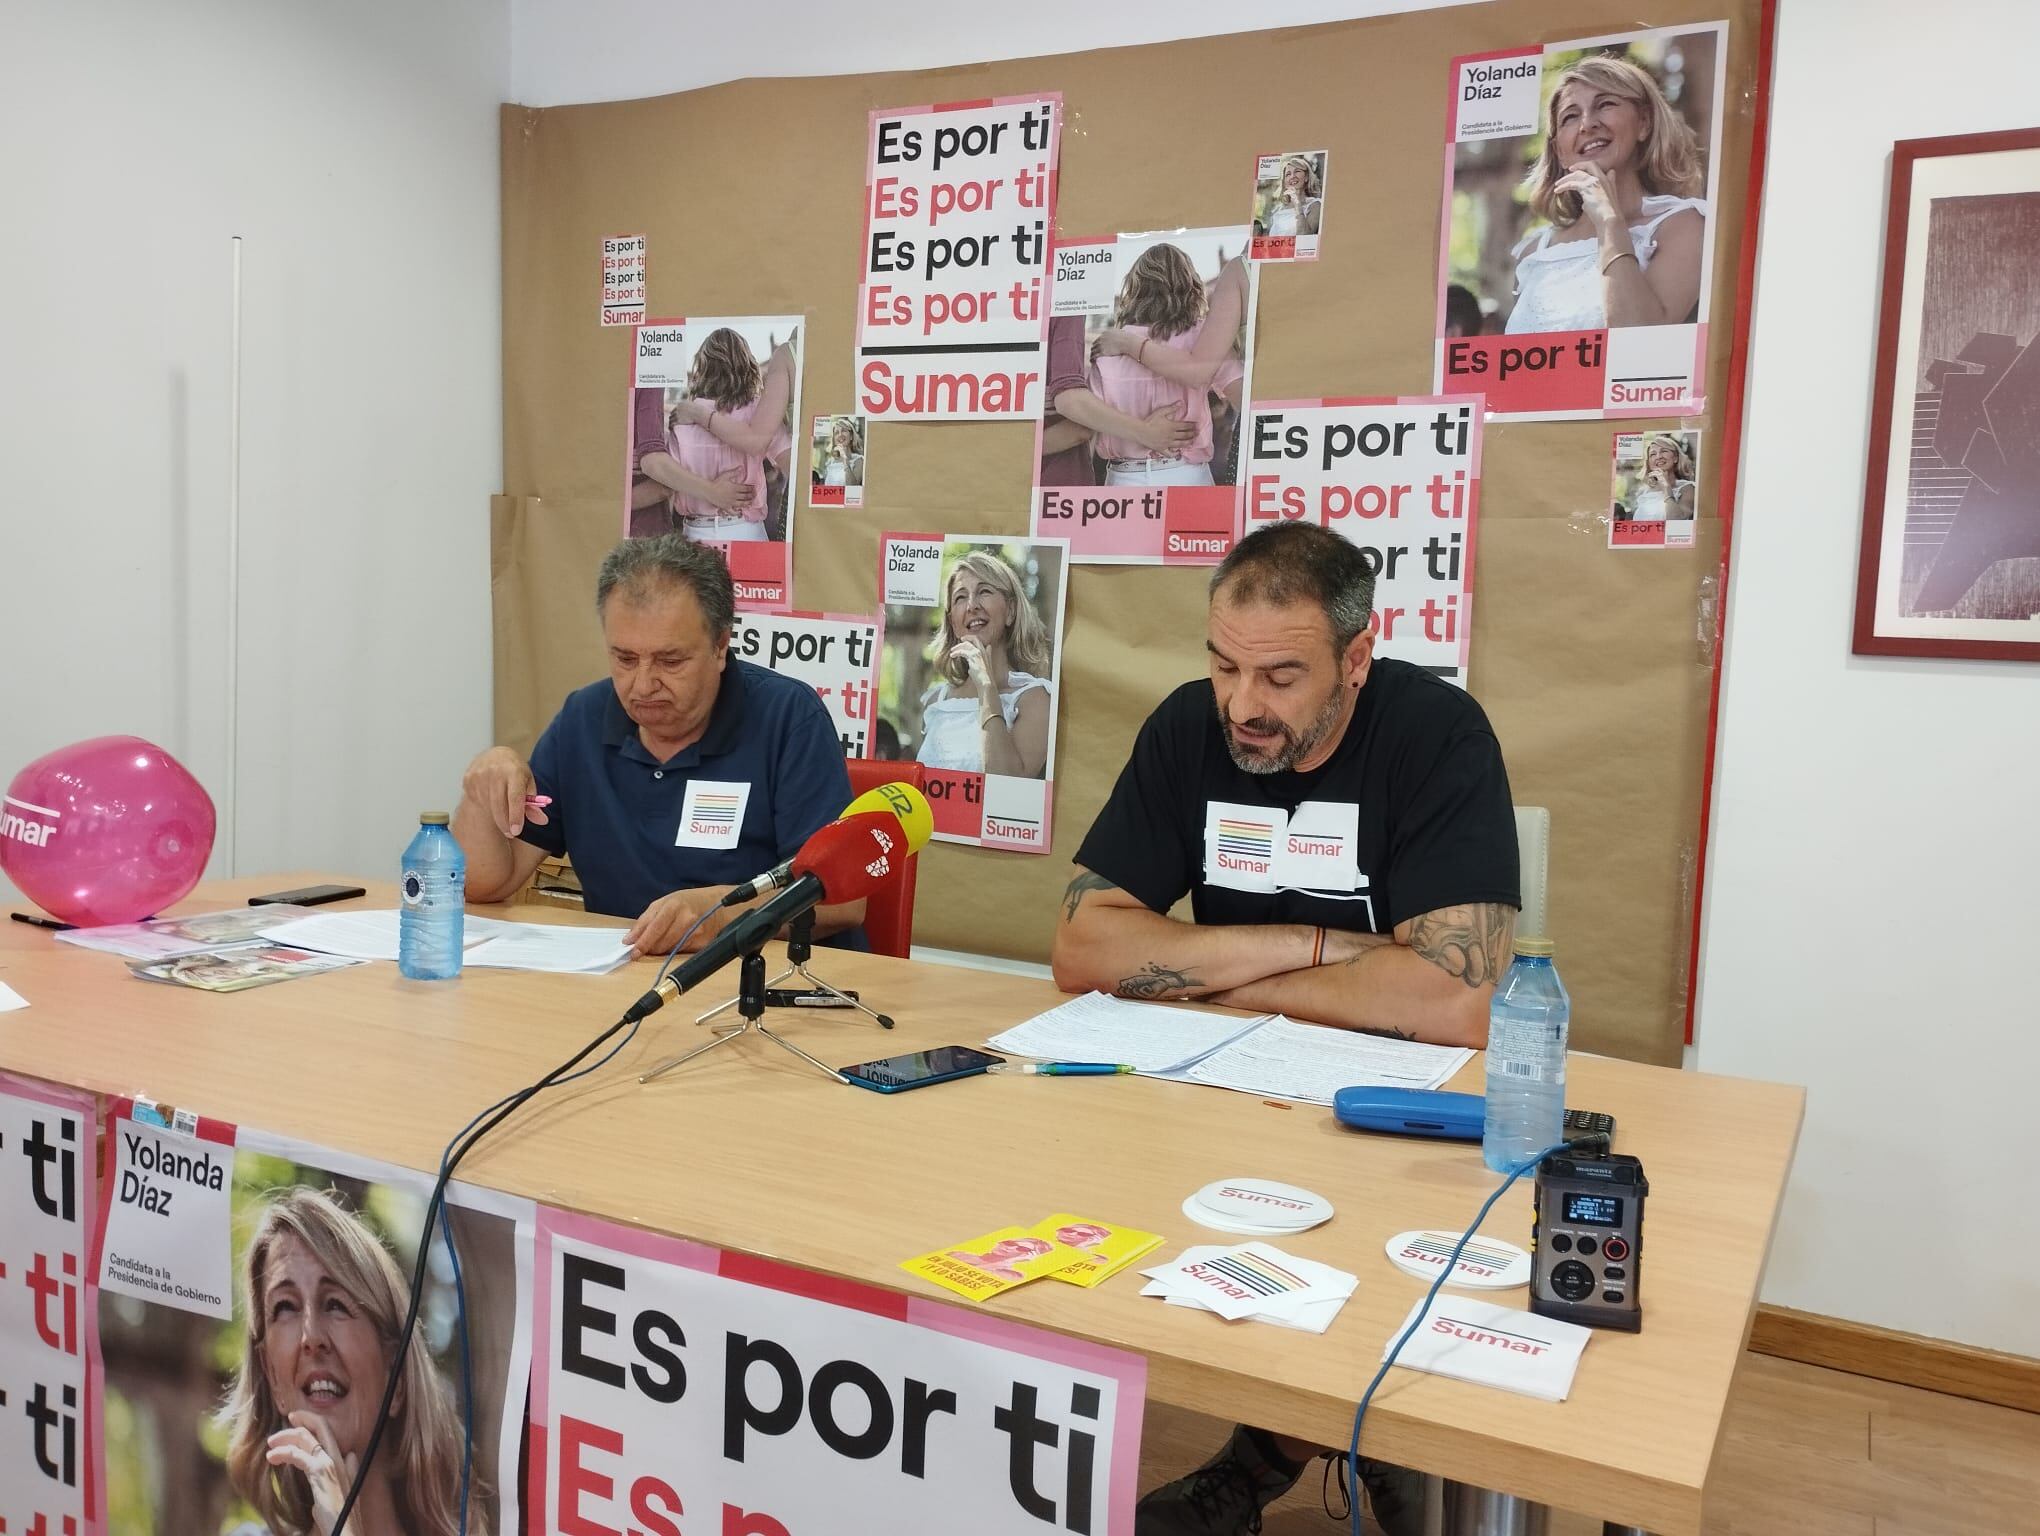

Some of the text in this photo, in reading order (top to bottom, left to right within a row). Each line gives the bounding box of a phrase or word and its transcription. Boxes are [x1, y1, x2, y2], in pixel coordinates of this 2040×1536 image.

[1467, 62, 1537, 84] Yolanda
[1464, 84, 1502, 101] Díaz
[1461, 121, 1492, 130] Candidata
[1461, 128, 1496, 136] Presidencia
[1504, 124, 1532, 132] Gobierno
[878, 106, 1050, 171] Es por ti
[874, 163, 1046, 226] Es por ti
[604, 238, 644, 255] Es por ti
[870, 221, 1044, 280] Es por ti
[1253, 240, 1264, 248] Es
[604, 254, 644, 270] Es por ti
[1058, 249, 1112, 266] Yolanda
[605, 269, 644, 286] Es por ti
[1056, 266, 1086, 282] Díaz
[605, 285, 644, 302] Es por ti
[603, 309, 644, 324] Sumar
[868, 278, 1040, 336] Es por ti
[640, 329, 683, 343] Yolanda
[640, 344, 662, 357] Díaz
[1448, 334, 1602, 380] Es por ti
[862, 361, 1038, 414] Sumar
[1610, 384, 1686, 403] Sumar
[1253, 408, 1470, 470] Es por ti
[812, 486, 822, 495] Es
[824, 488, 837, 496] por
[1251, 470, 1465, 528] Es por ti
[1042, 490, 1163, 526] Es por ti
[1614, 522, 1664, 535] Es por ti
[890, 544, 940, 559] Yolanda
[1168, 534, 1229, 554] Sumar
[888, 558, 915, 572] Díaz
[1358, 533, 1462, 581] or ti
[733, 583, 782, 600] Sumar
[1419, 595, 1457, 642] ti
[770, 630, 835, 669] por
[845, 627, 874, 668] ti
[841, 680, 868, 720] ti
[962, 776, 982, 804] ti
[0, 808, 57, 848] umar
[690, 821, 733, 835] Sumar
[986, 820, 1039, 841] Sumar
[1288, 838, 1343, 857] Sumar
[1218, 854, 1270, 874] Sumar
[22, 1116, 76, 1222] ti
[124, 1132, 224, 1192] Yolanda
[120, 1169, 173, 1217] Díaz
[1218, 1188, 1311, 1211] Sumar
[110, 1252, 171, 1280] Candidata a la
[927, 1255, 943, 1263] EN
[963, 1270, 980, 1278] SE
[975, 1274, 1006, 1288] VOTA
[1072, 1262, 1097, 1272] OTA
[108, 1267, 222, 1306] Presidencia de Gobierno
[1181, 1264, 1256, 1300] Sumar
[26, 1252, 78, 1356] ti
[1432, 1319, 1548, 1356] Sumar
[561, 1252, 1102, 1536] Es por ti
[26, 1382, 76, 1488] ti
[558, 1414, 686, 1536] Es
